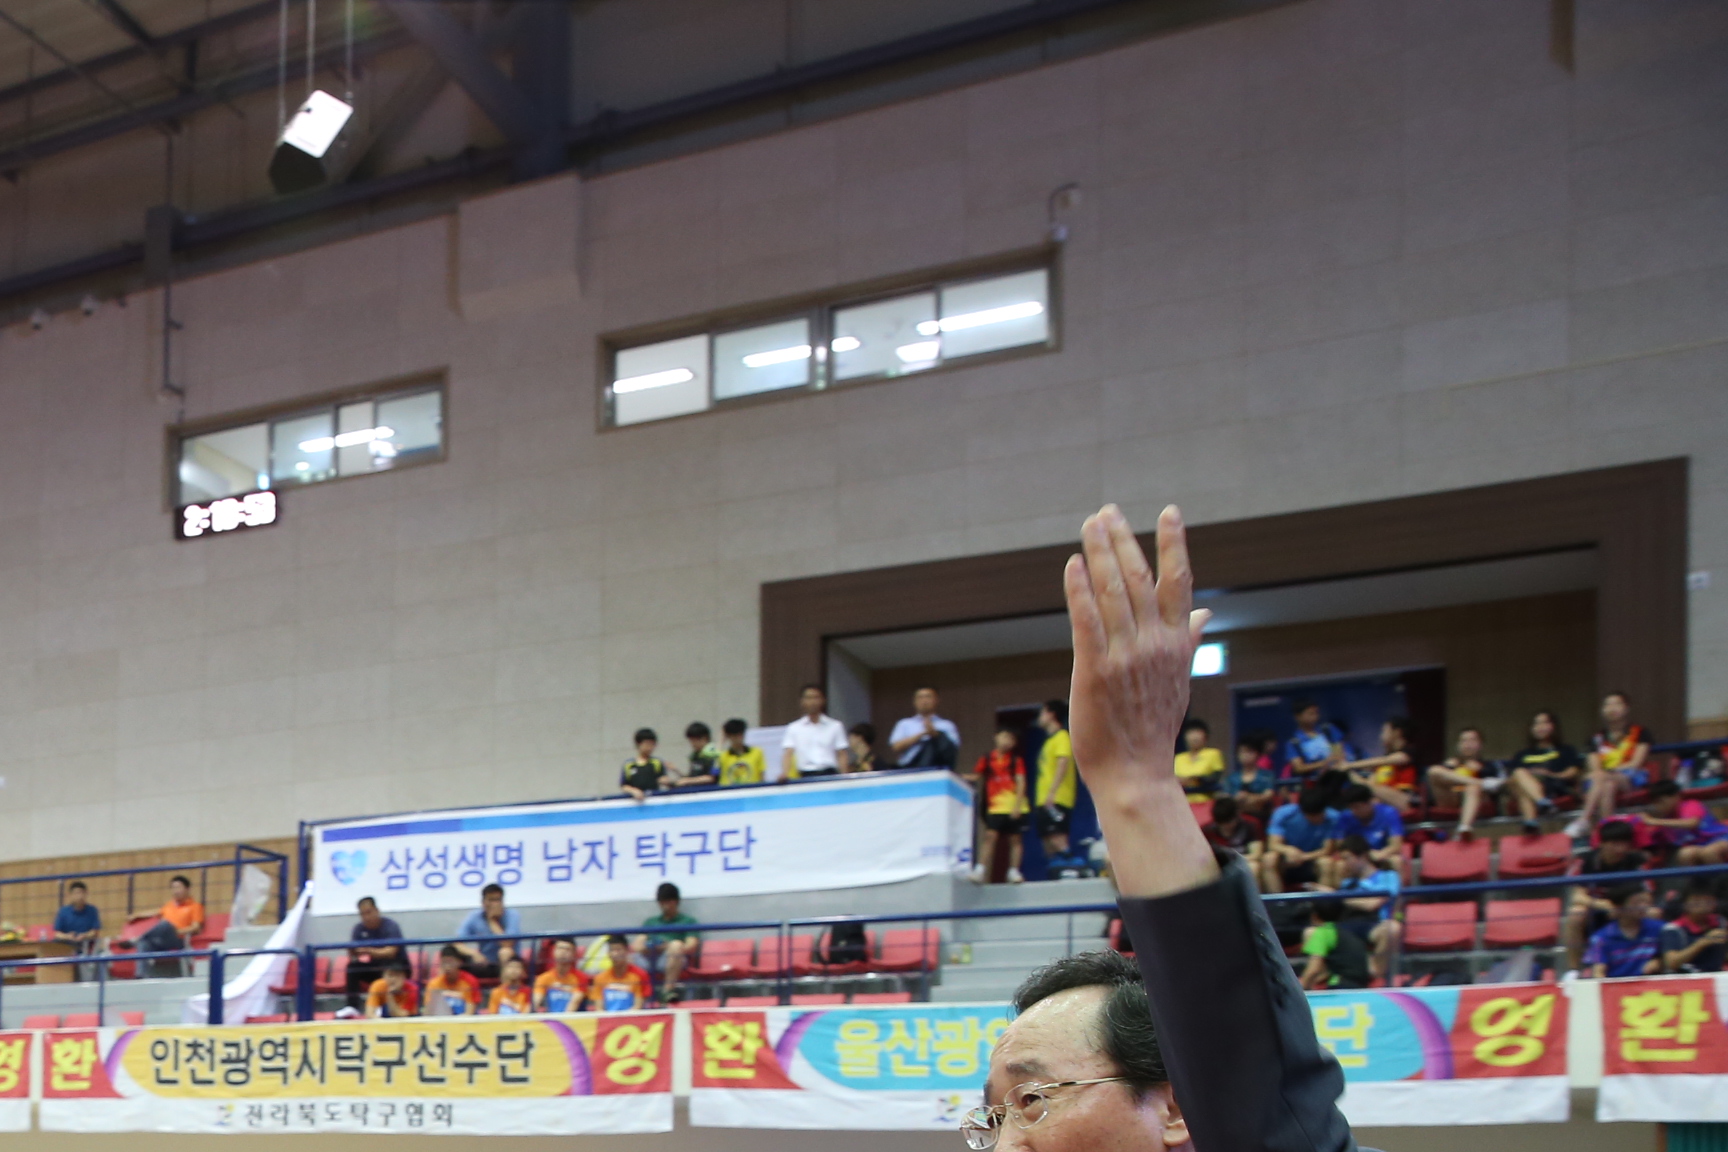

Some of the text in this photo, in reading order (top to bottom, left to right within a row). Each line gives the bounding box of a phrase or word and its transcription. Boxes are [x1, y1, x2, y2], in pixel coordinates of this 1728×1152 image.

[380, 825, 757, 891] 삼성생명 남자 탁구단
[50, 1022, 665, 1091] 환 인천광역시탁구선수단 영
[703, 1020, 763, 1080] 환
[1472, 994, 1555, 1067] 영
[1619, 989, 1710, 1063] 환
